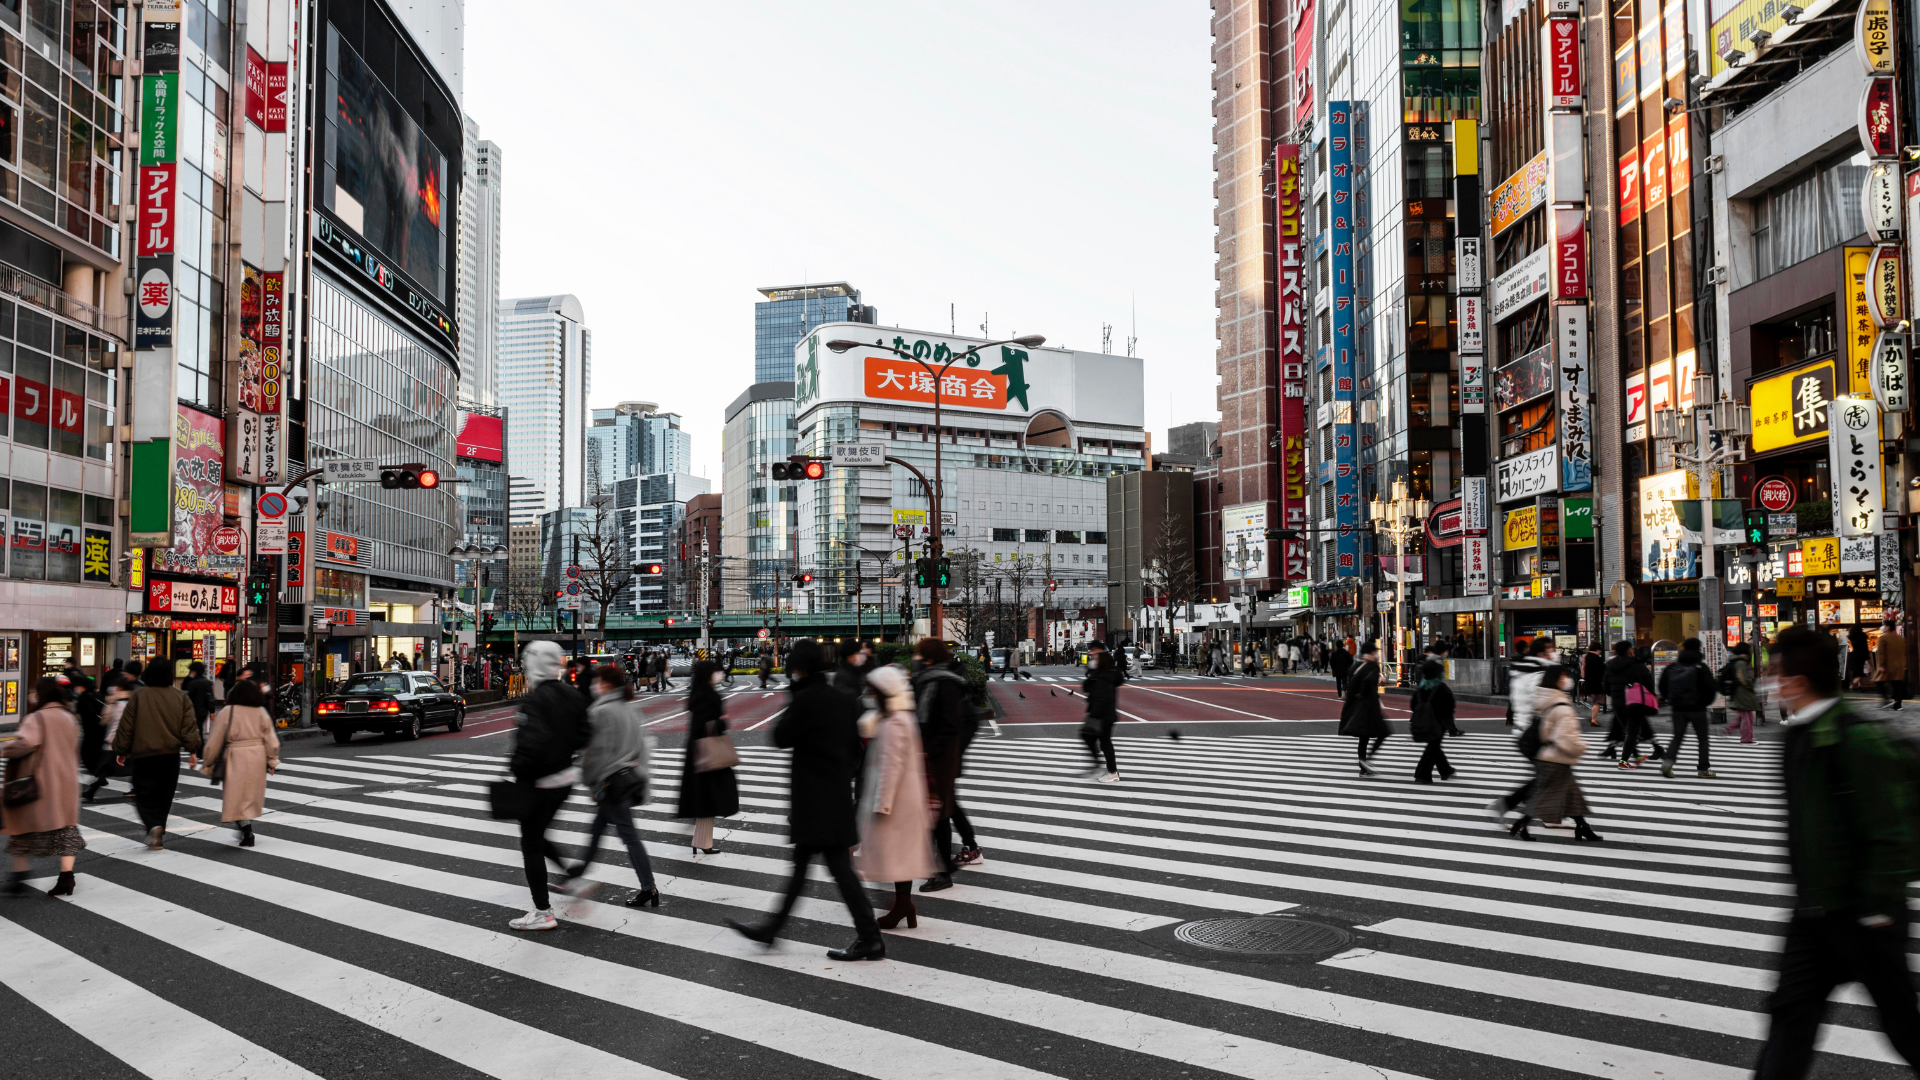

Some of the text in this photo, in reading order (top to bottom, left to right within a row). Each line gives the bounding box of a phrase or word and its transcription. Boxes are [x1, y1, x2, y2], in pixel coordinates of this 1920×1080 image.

[1557, 2, 1570, 10] 6F
[1719, 31, 1731, 49] B1
[1867, 16, 1889, 55] 虎の子
[247, 61, 264, 83] FAST
[1556, 38, 1575, 93] アイフル
[247, 75, 264, 99] NAIL
[1560, 97, 1574, 105] 5F
[1526, 161, 1546, 191] 焼き
[1650, 184, 1662, 202] 5F
[1881, 178, 1893, 227] とらそば
[147, 170, 169, 249] アイフル
[1881, 230, 1894, 239] 1F
[1564, 243, 1581, 284] アコム
[141, 281, 169, 306] 薬
[1420, 279, 1444, 288] すずや
[1565, 286, 1578, 294] 3F
[1883, 260, 1896, 316] お好み焼き
[264, 277, 281, 337] 飲み放題
[1494, 282, 1532, 317] お好み焼き本陣
[1466, 299, 1476, 330] お好み焼
[893, 336, 981, 367] たのめーる
[1885, 346, 1904, 391] かっぱ
[876, 367, 997, 400] 大塚商会
[1628, 365, 1695, 422] アコム
[1562, 363, 1591, 462] すしまみれ
[1794, 377, 1829, 430] 集
[1888, 396, 1903, 405] B1
[1847, 404, 1866, 427] 虎
[1632, 428, 1643, 439] 3F
[466, 447, 477, 456] 2F
[836, 446, 880, 457] 歌舞伎町
[1511, 450, 1553, 477] メンズライフ
[328, 462, 374, 473] 歌舞伎町
[1511, 474, 1546, 498] クリニック
[1850, 433, 1875, 530] とらそば
[1337, 434, 1354, 567] カラオケ館
[1763, 490, 1787, 501] 消火栓
[1566, 507, 1590, 516] レイク
[1769, 516, 1796, 524] セキネ
[216, 535, 238, 545] 消火栓
[84, 535, 110, 576] 薬
[219, 556, 245, 564] セキネ
[287, 536, 302, 582] 吉野家
[1472, 540, 1482, 571] お好み焼
[1822, 543, 1837, 570] 集
[190, 587, 219, 611] 日高屋
[224, 588, 235, 603] 24
